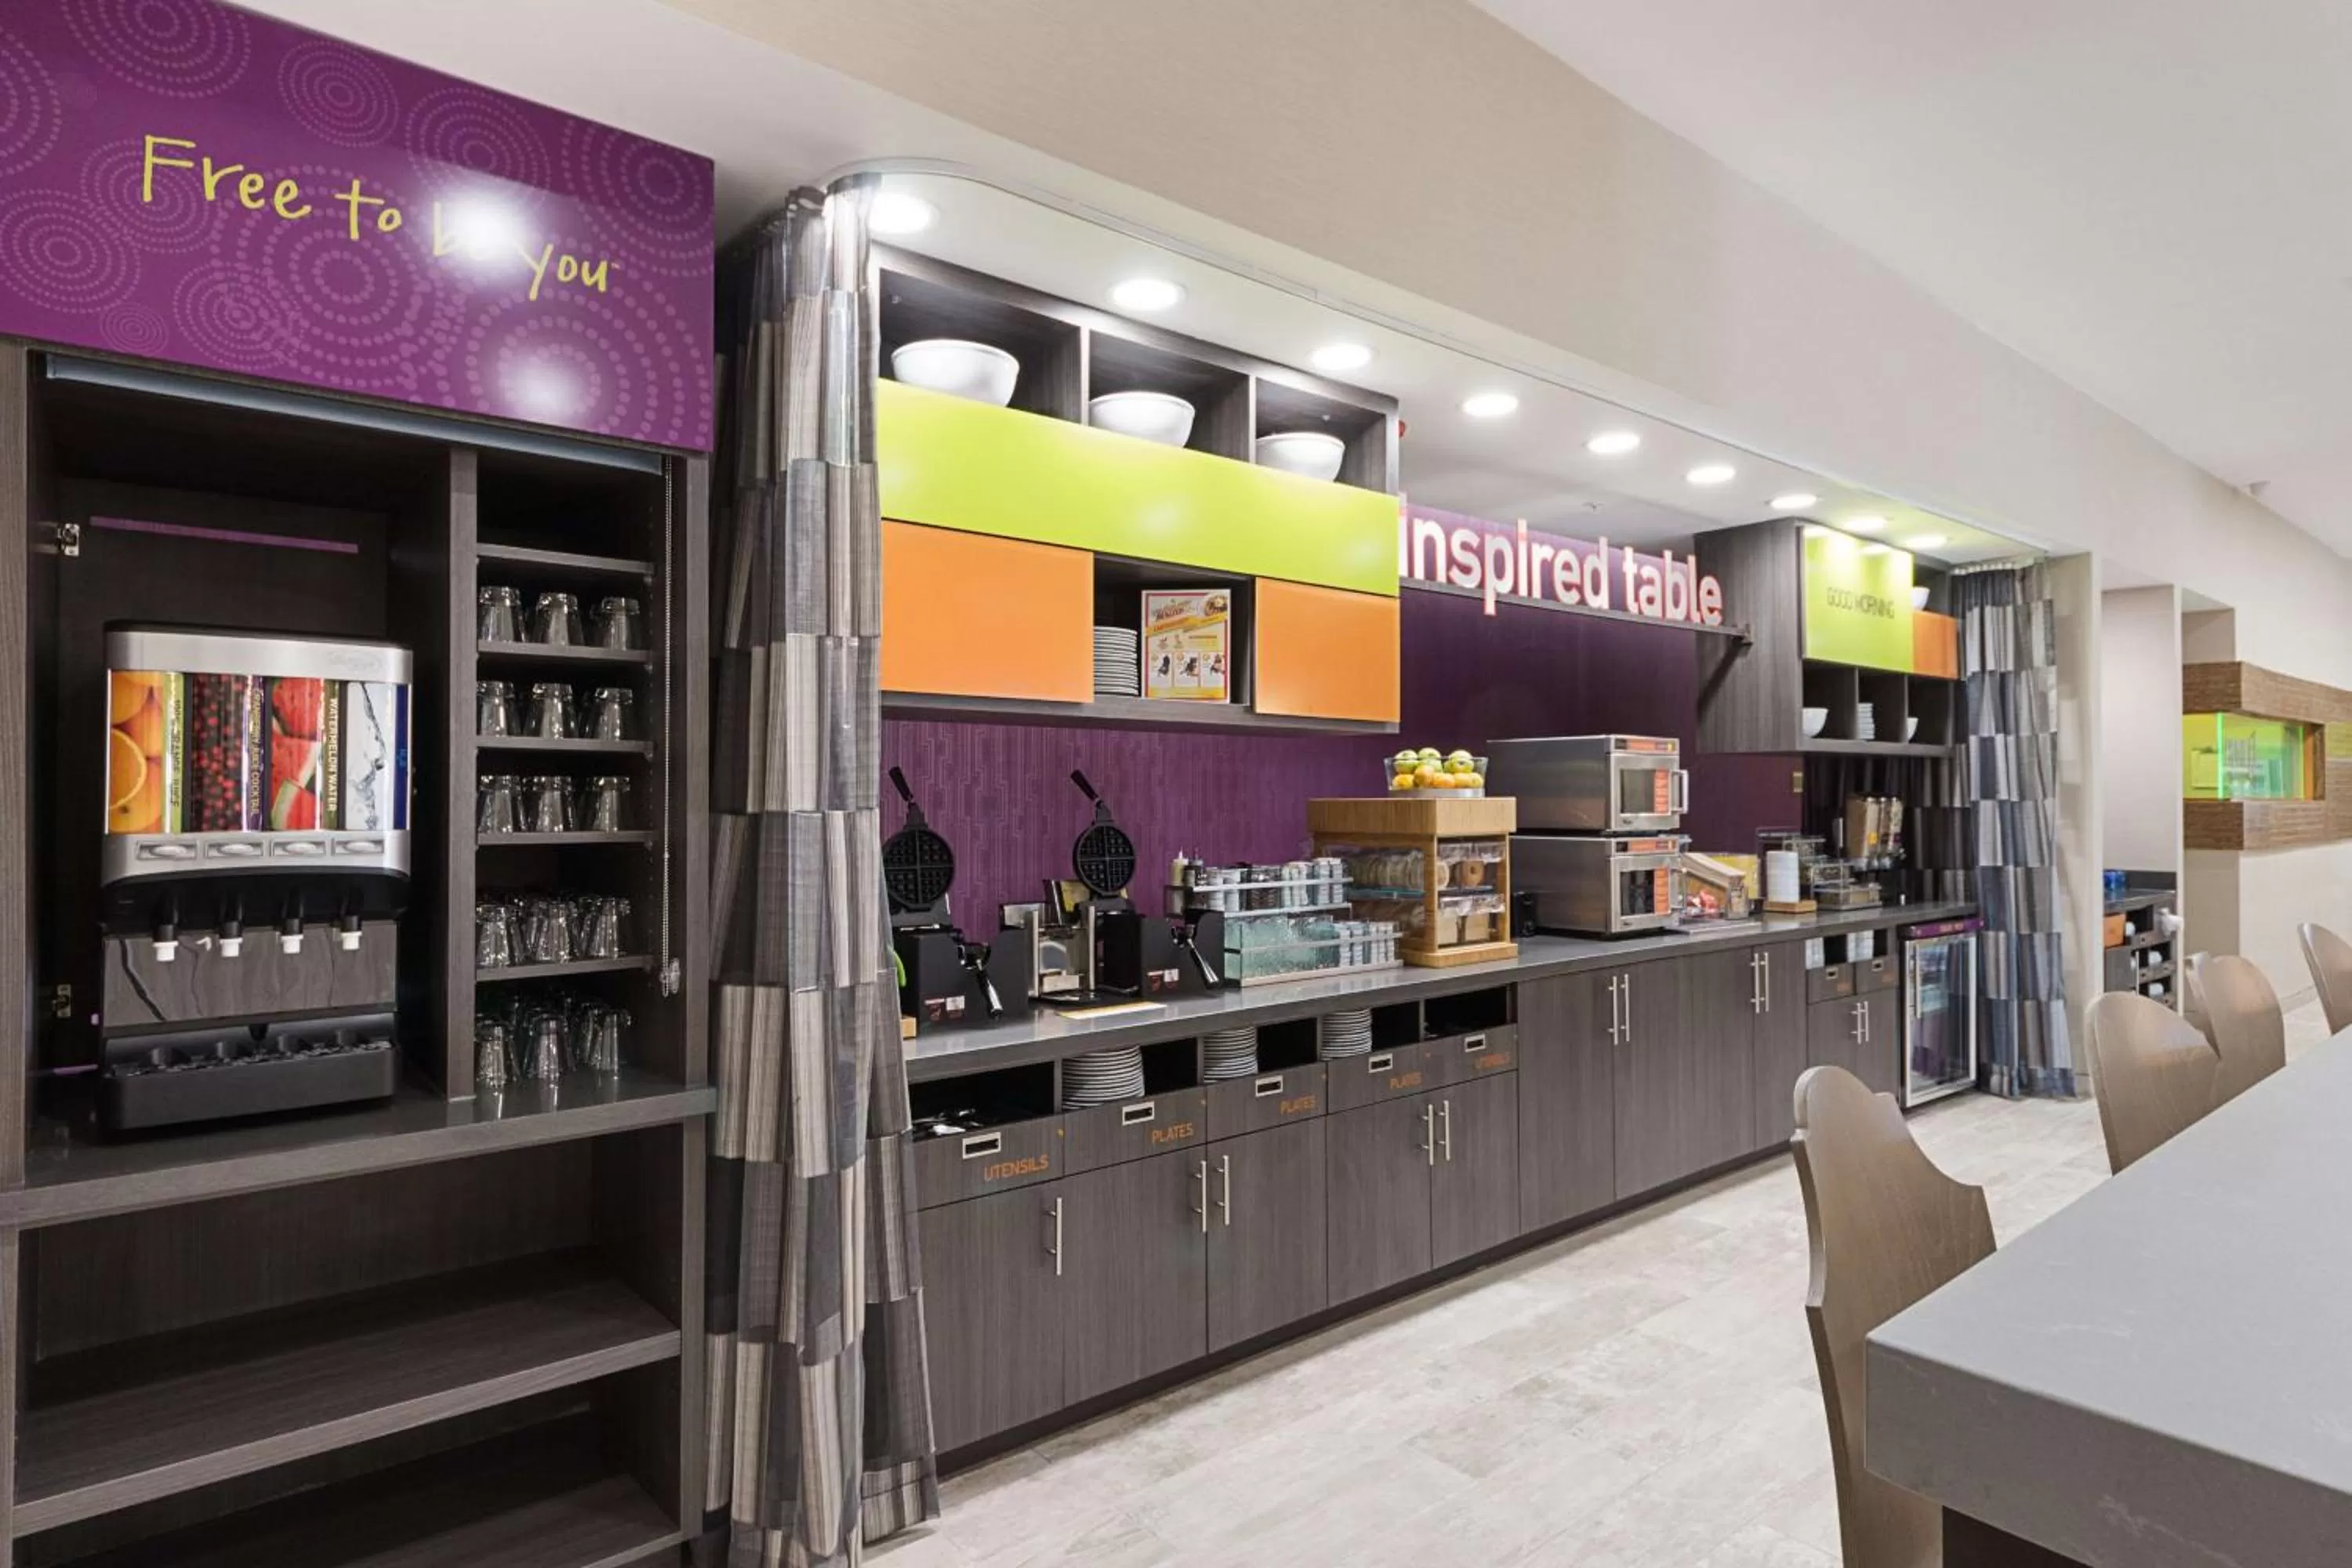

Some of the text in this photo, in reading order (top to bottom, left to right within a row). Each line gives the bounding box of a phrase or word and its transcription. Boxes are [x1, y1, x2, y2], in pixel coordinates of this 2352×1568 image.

[143, 134, 313, 219] Free
[334, 179, 402, 240] to
[514, 242, 608, 302] you
[1399, 492, 1723, 626] inspired table
[325, 698, 339, 811] WATERMELON WATER
[1152, 1123, 1194, 1143] PLATES
[1280, 1094, 1318, 1115] PLATES
[984, 1154, 1049, 1181] UTENSILS
